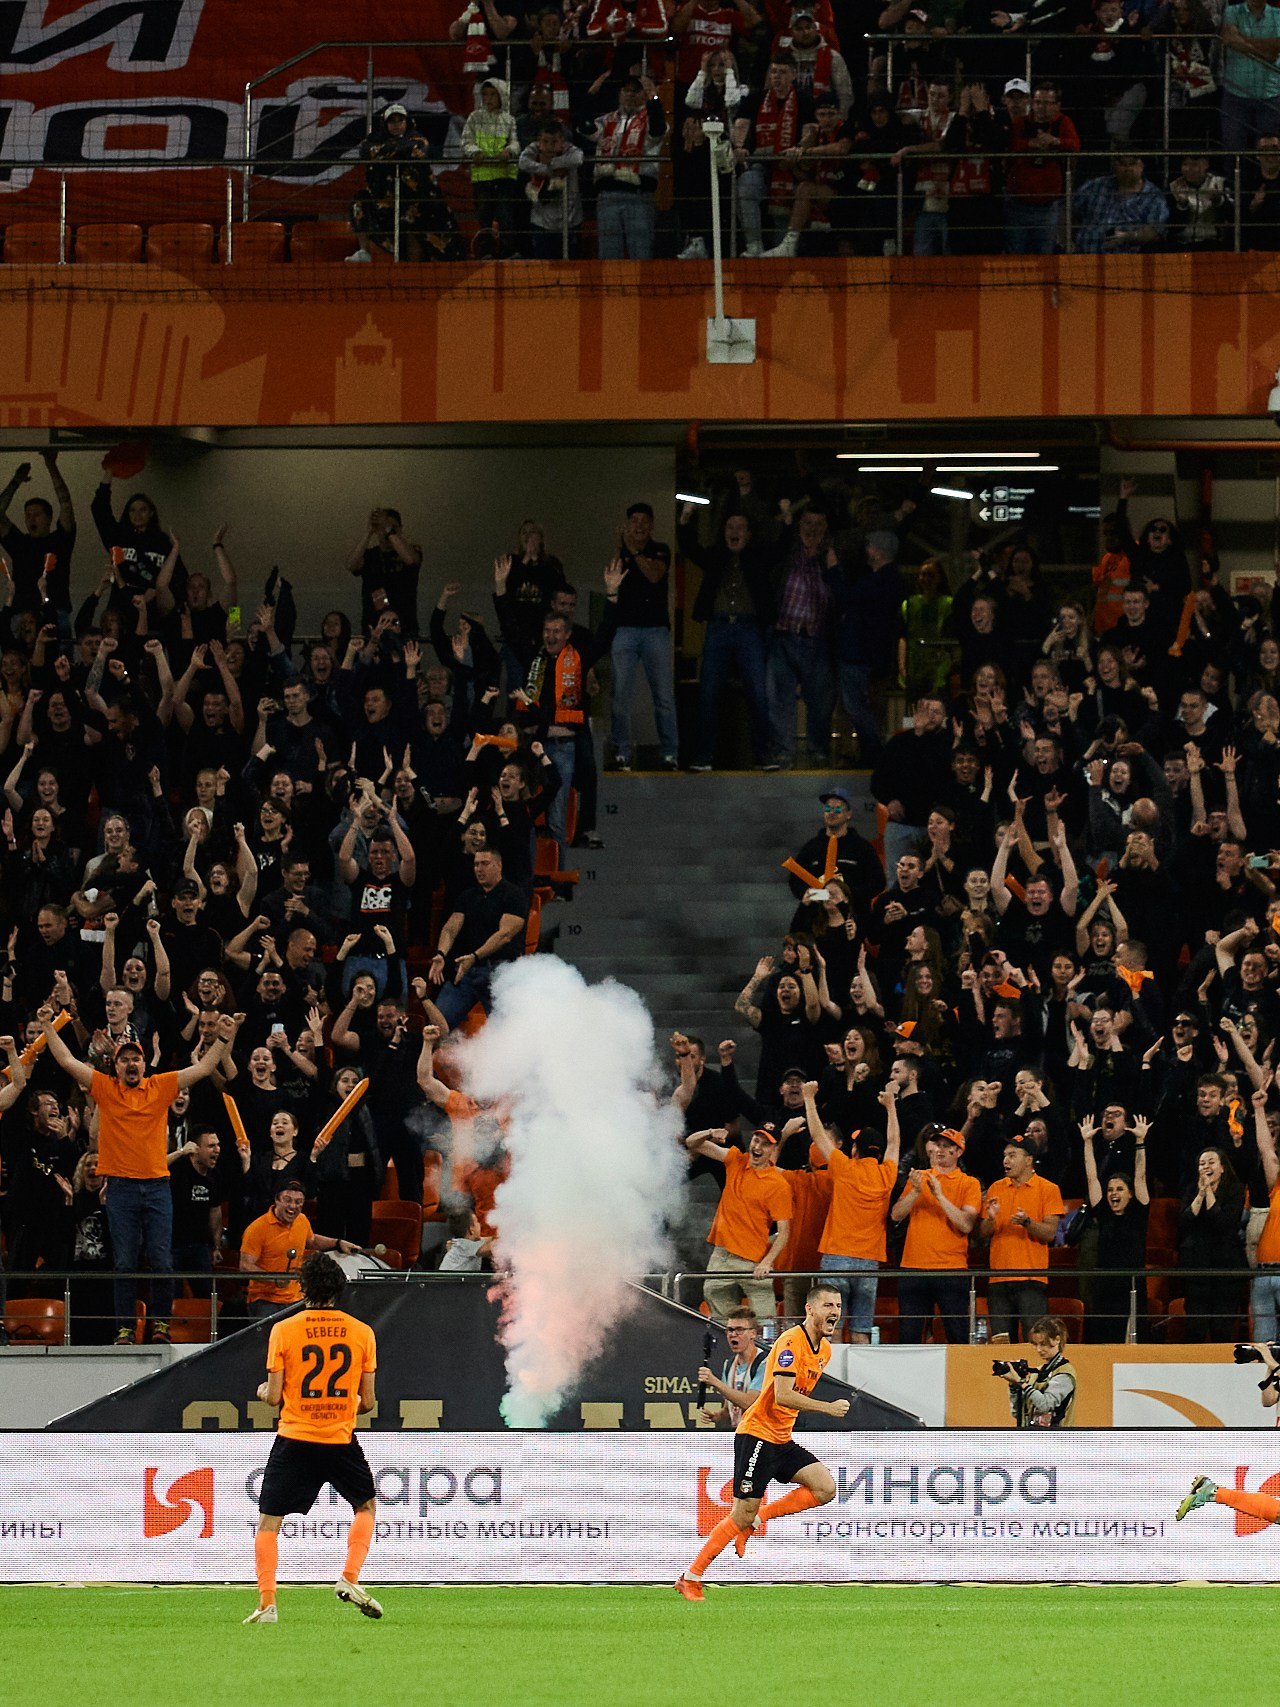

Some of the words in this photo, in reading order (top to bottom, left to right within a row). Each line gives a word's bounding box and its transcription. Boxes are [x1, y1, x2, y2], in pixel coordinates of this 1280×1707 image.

[606, 804, 619, 815] 12
[586, 870, 597, 880] 11
[568, 924, 582, 935] 10
[305, 1326, 347, 1339] БЕВЕЕВ
[301, 1343, 352, 1399] 22
[745, 1440, 763, 1478] BetBoom
[478, 1520, 609, 1539] машины
[803, 1520, 1023, 1542] транспортные
[1032, 1520, 1164, 1538] машины
